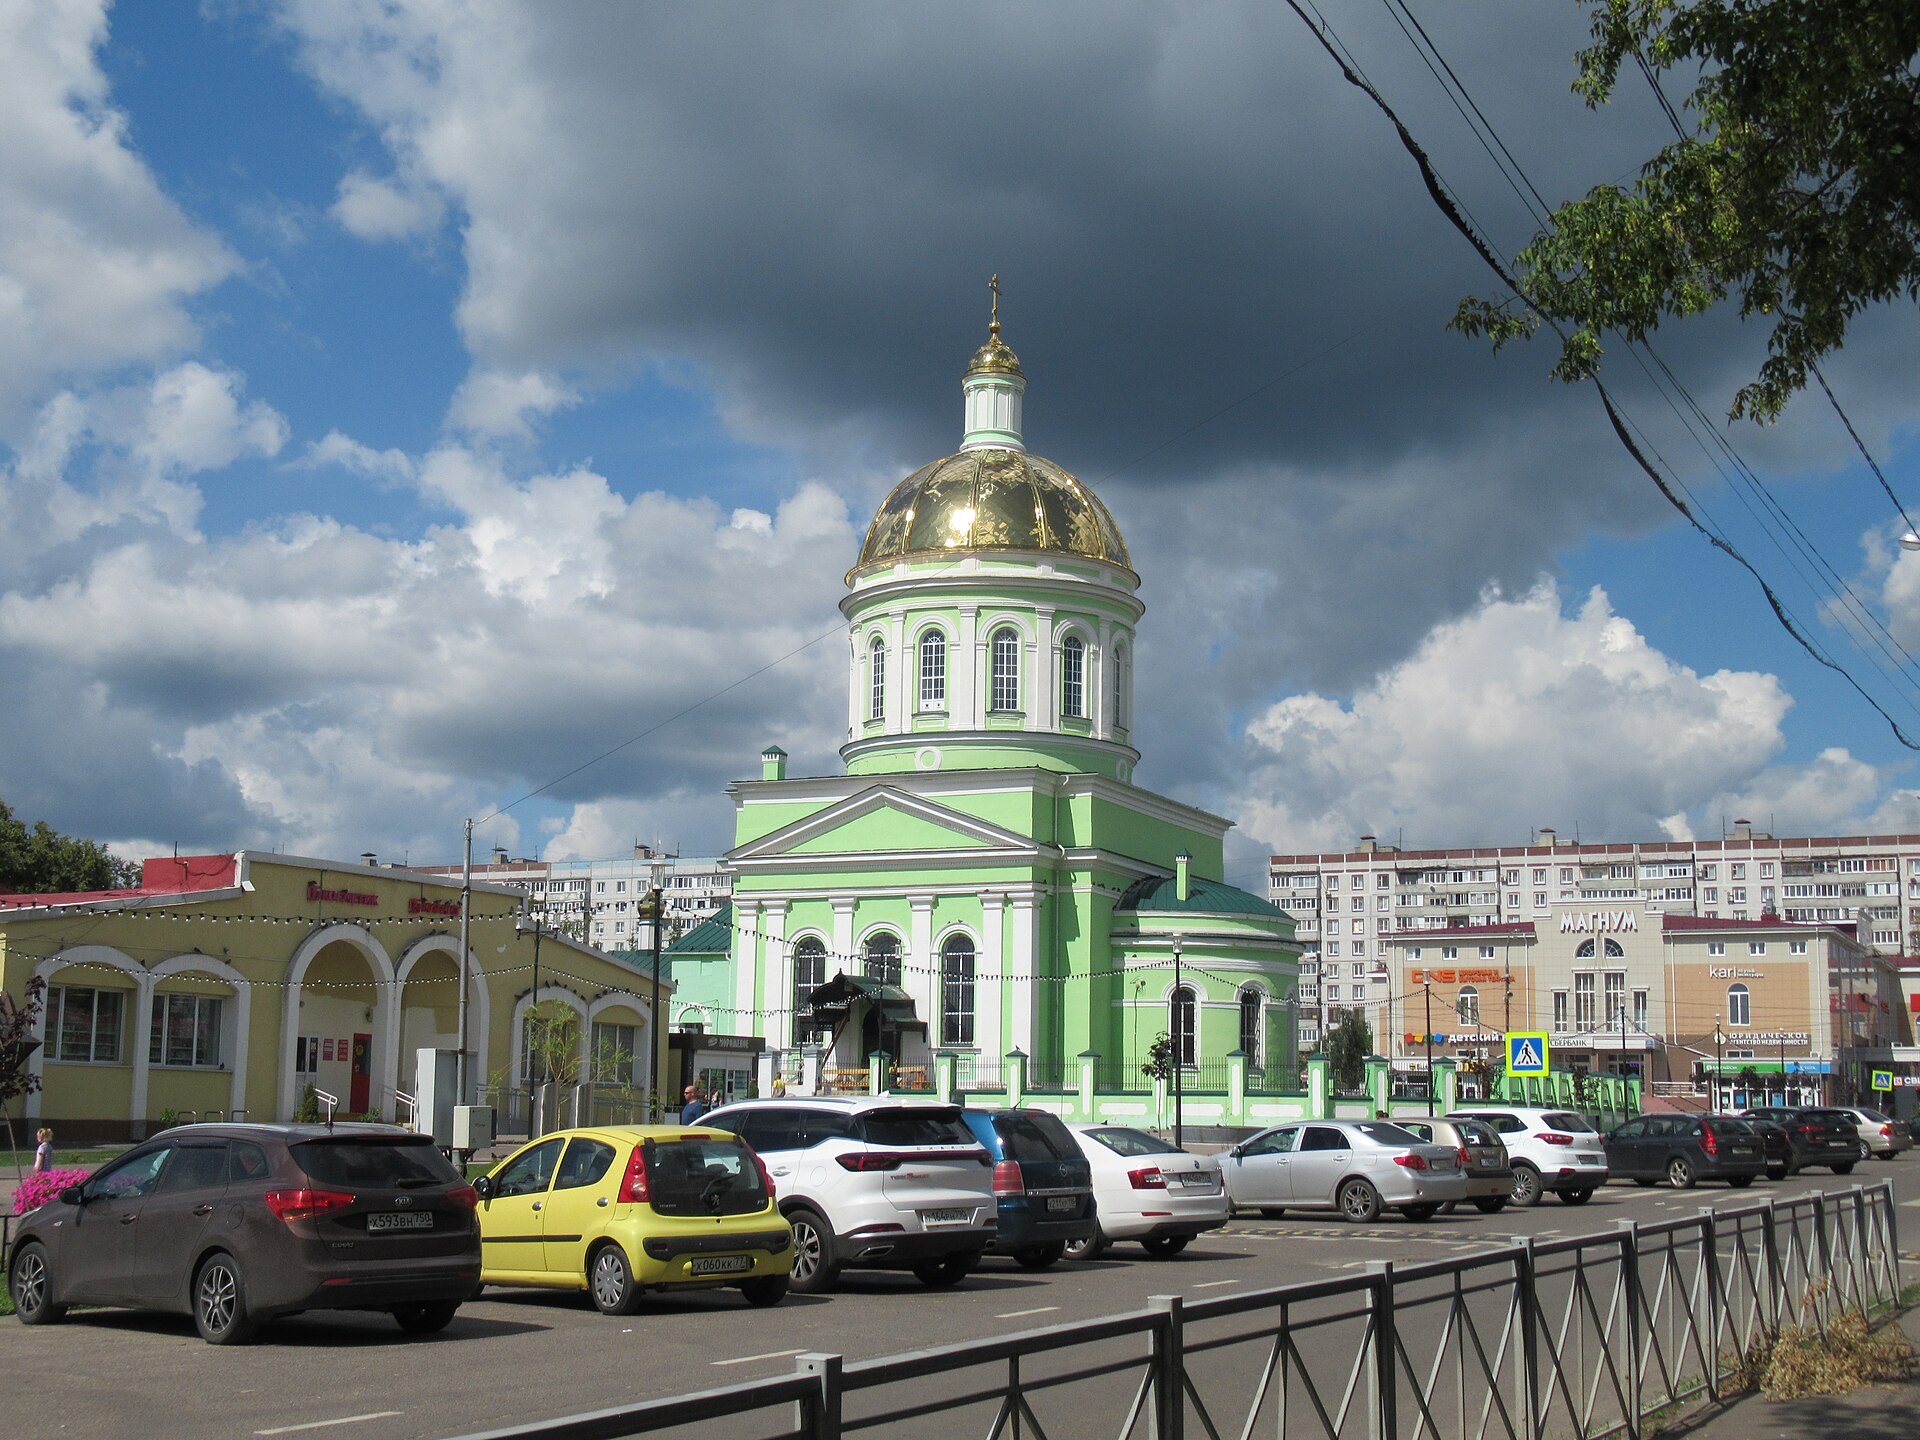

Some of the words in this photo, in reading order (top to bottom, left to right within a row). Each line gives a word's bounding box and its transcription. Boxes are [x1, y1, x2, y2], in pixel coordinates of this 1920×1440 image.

[1560, 909, 1638, 932] МАГНУМ
[1448, 1030, 1499, 1043] детский
[1729, 1032, 1808, 1040] ЮРИДИЧЕСКОЕ
[1549, 1039, 1587, 1047] СБЕРБАНК
